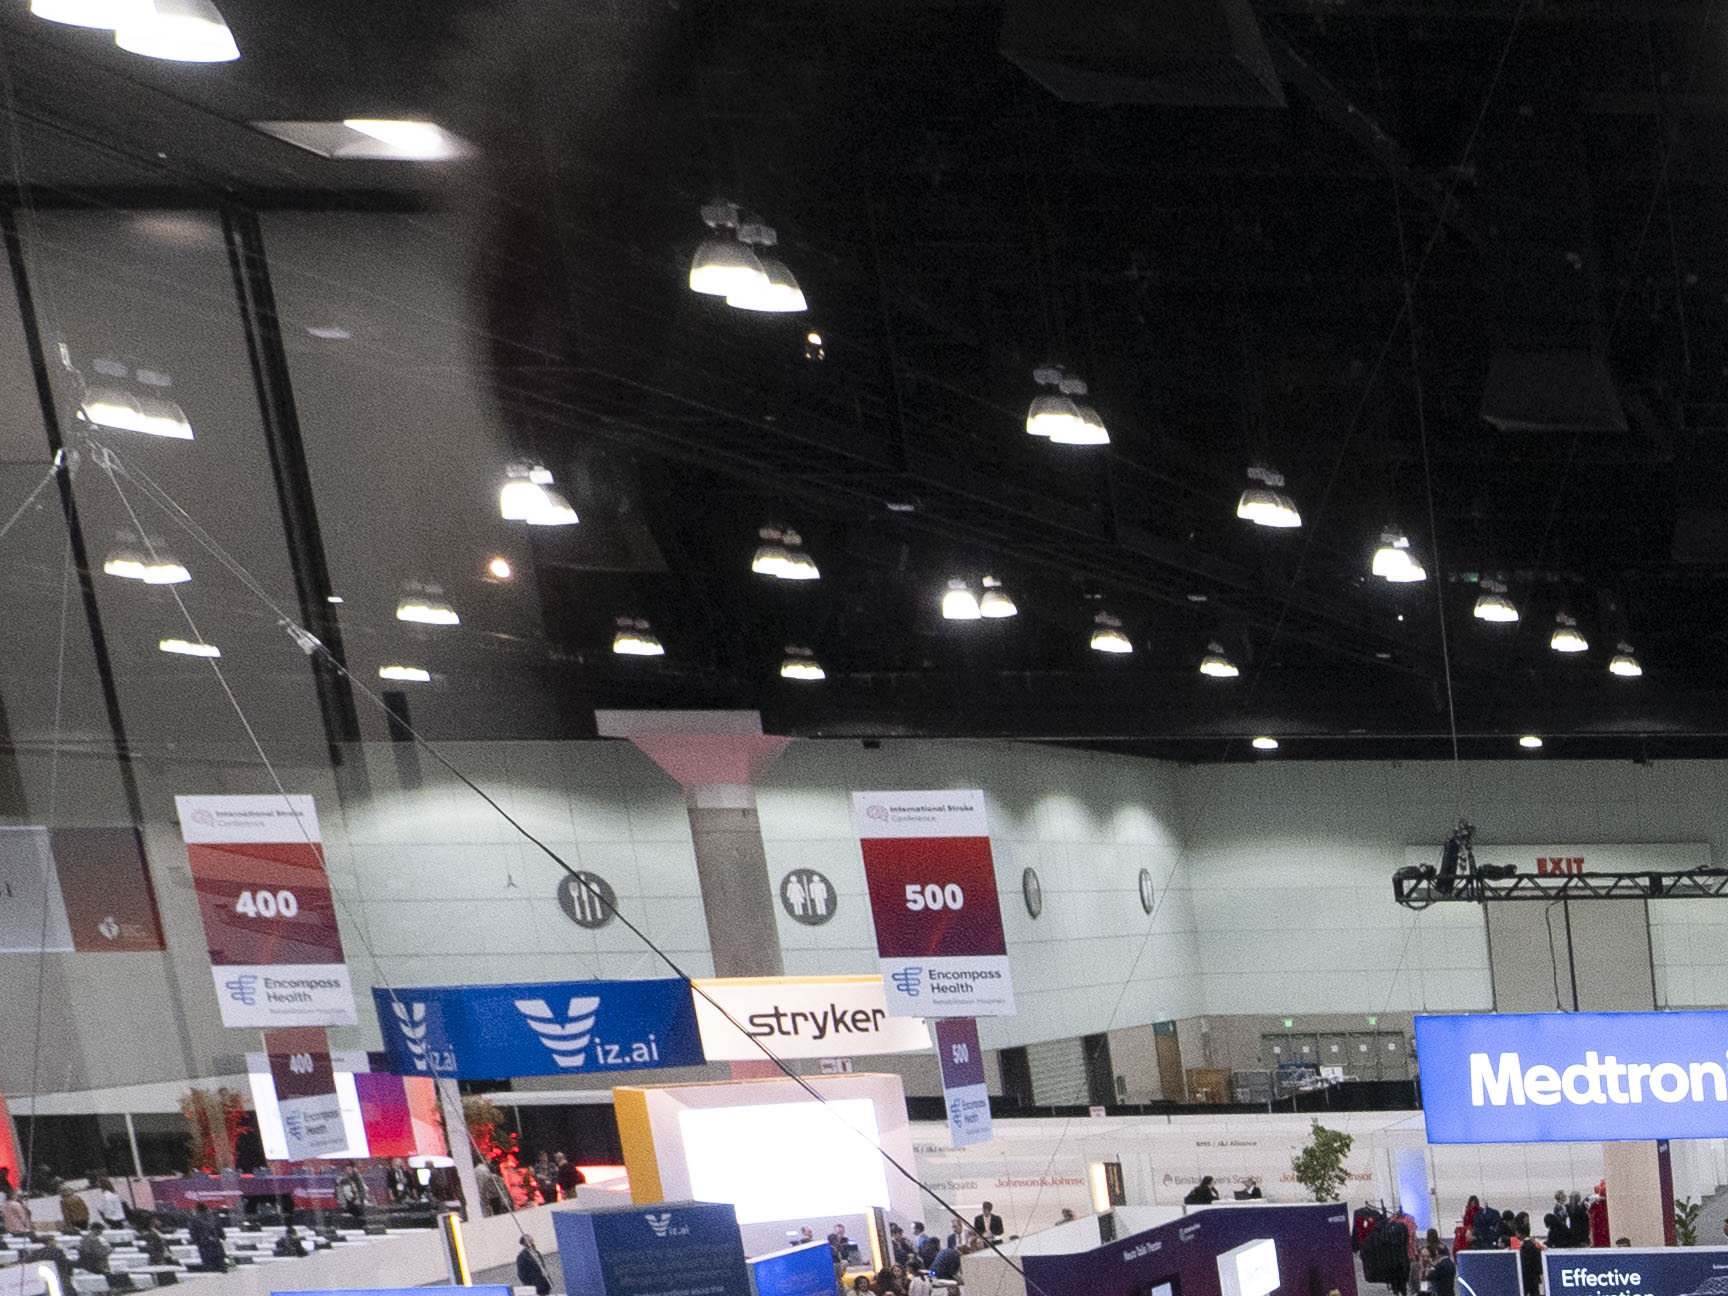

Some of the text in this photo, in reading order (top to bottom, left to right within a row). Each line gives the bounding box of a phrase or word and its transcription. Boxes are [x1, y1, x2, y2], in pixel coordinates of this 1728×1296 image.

[1537, 857, 1585, 874] EXIT
[235, 890, 298, 919] 400
[904, 883, 964, 911] 500
[264, 976, 342, 992] Encompass
[928, 968, 1002, 983] Encompass
[267, 990, 313, 1003] Health
[930, 982, 974, 994] Health
[748, 1003, 886, 1041] stryker
[951, 1043, 969, 1065] 500
[1561, 1268, 1642, 1287] Effective
